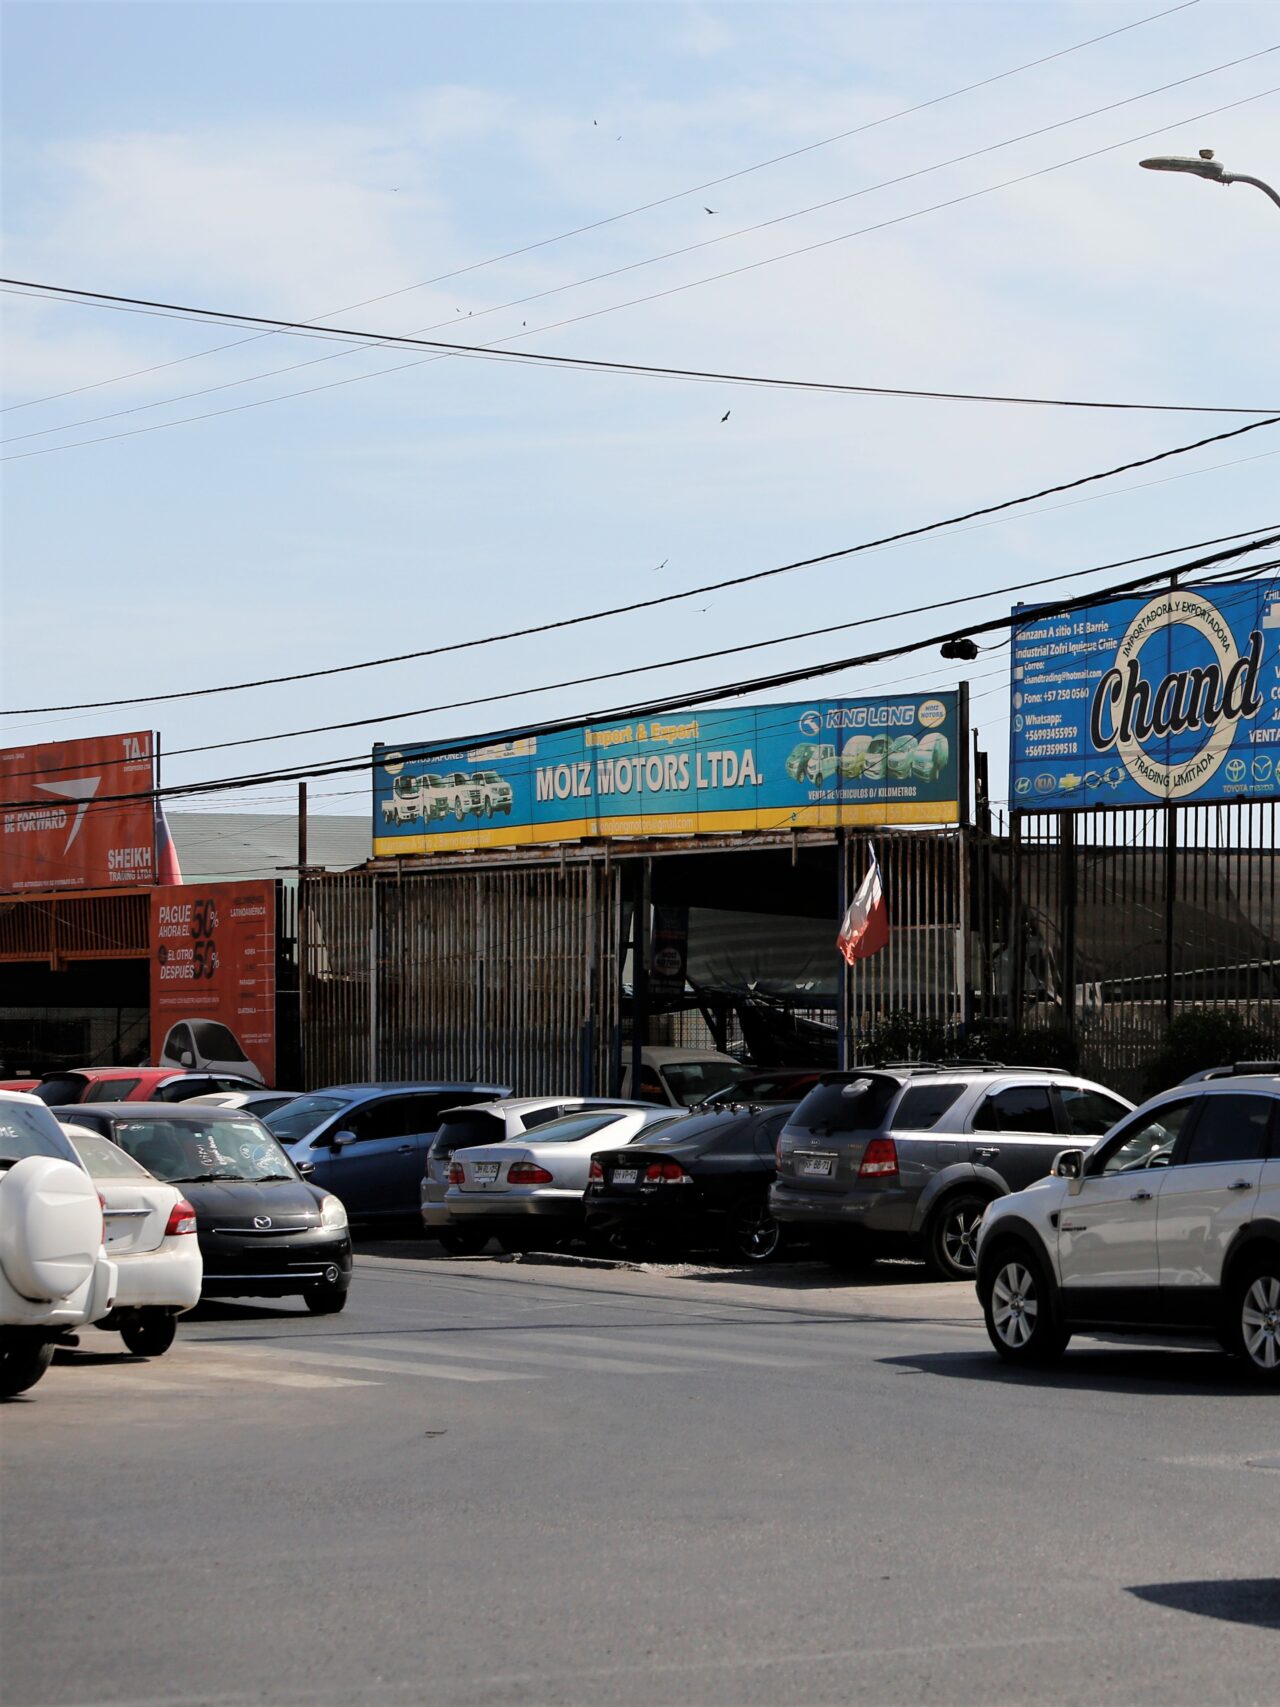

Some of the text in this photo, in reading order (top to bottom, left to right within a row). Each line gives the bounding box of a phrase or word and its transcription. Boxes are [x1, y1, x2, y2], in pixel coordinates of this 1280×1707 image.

[1122, 601, 1231, 658] IMPORTADORA Y EXPORTADORA
[1090, 630, 1264, 753] Chand
[826, 705, 916, 728] KING LONG
[636, 723, 648, 742] &
[651, 720, 699, 744] Export
[122, 736, 149, 763] TAJ
[536, 748, 763, 801] MOIZ MOTORS LTDA.
[1134, 753, 1215, 787] TRADING LIMITADA
[1223, 784, 1248, 793] TOYOTA
[4, 809, 67, 833] BE FORWARD
[108, 847, 152, 869] SHEIKH
[159, 905, 192, 923] PAGUE
[158, 924, 190, 938] AHORA EL
[167, 950, 176, 960] EL
[176, 949, 193, 960] OTRO
[160, 962, 195, 979] DESPUÉS
